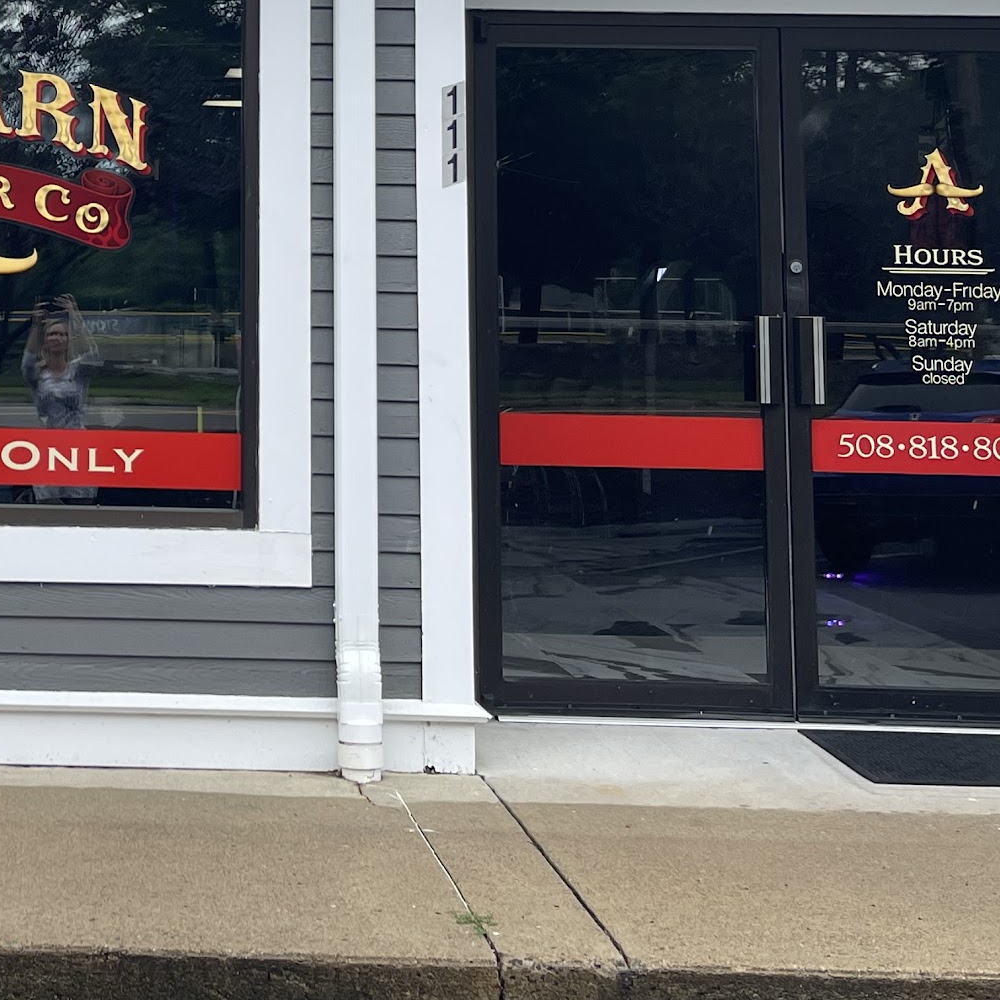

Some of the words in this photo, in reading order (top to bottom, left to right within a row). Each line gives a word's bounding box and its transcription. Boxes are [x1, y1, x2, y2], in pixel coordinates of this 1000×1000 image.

[446, 85, 458, 183] 111
[35, 183, 110, 235] CO
[893, 244, 984, 266] HOURS
[907, 298, 974, 314] 9am-7pm
[904, 318, 978, 339] Saturday
[908, 335, 976, 350] 8am-4pm
[911, 354, 973, 376] Sunday
[922, 372, 965, 385] closed
[0, 440, 144, 474] ONLY
